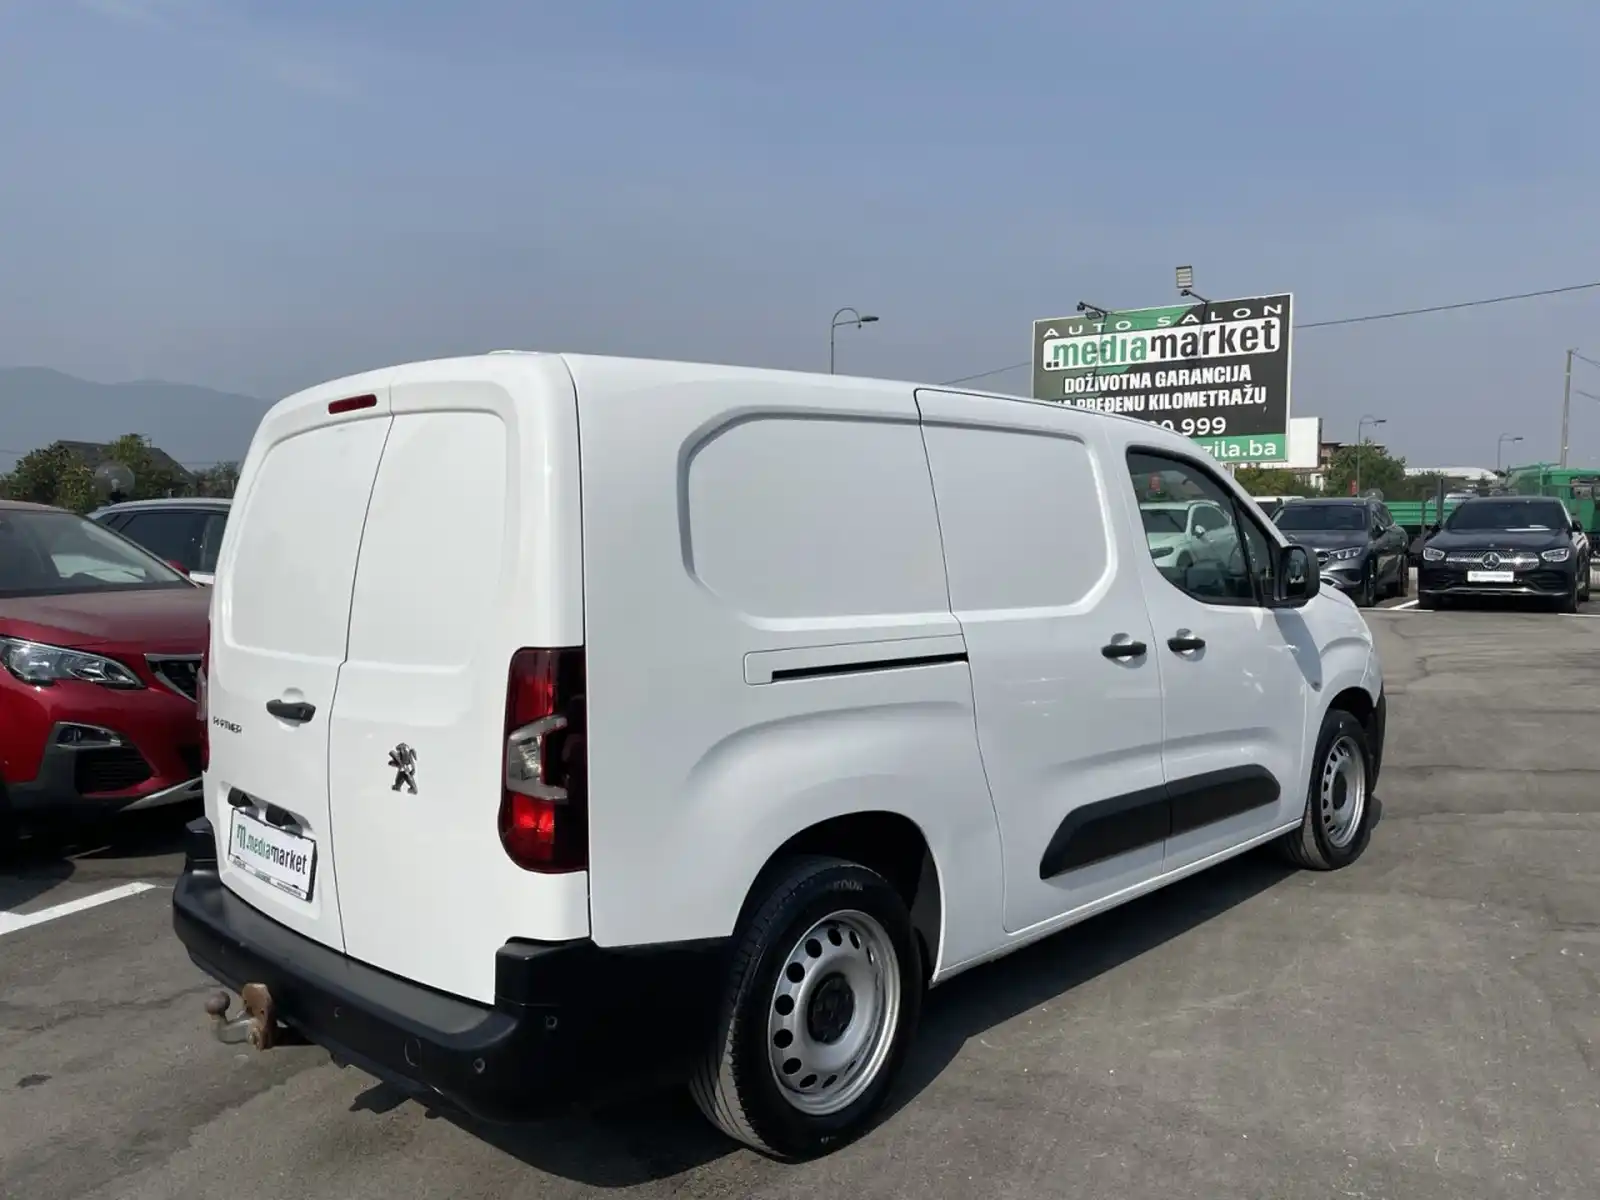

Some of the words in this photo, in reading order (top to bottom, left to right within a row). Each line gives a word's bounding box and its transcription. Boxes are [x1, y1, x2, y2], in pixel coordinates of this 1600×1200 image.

[1043, 320, 1132, 338] AUTO
[1157, 304, 1282, 327] SALON
[1064, 372, 1152, 394] DOŽIVOTNA
[1155, 364, 1252, 388] GARANCIJA
[1149, 384, 1267, 411] KILOMETRAŽU
[1181, 416, 1226, 436] 999
